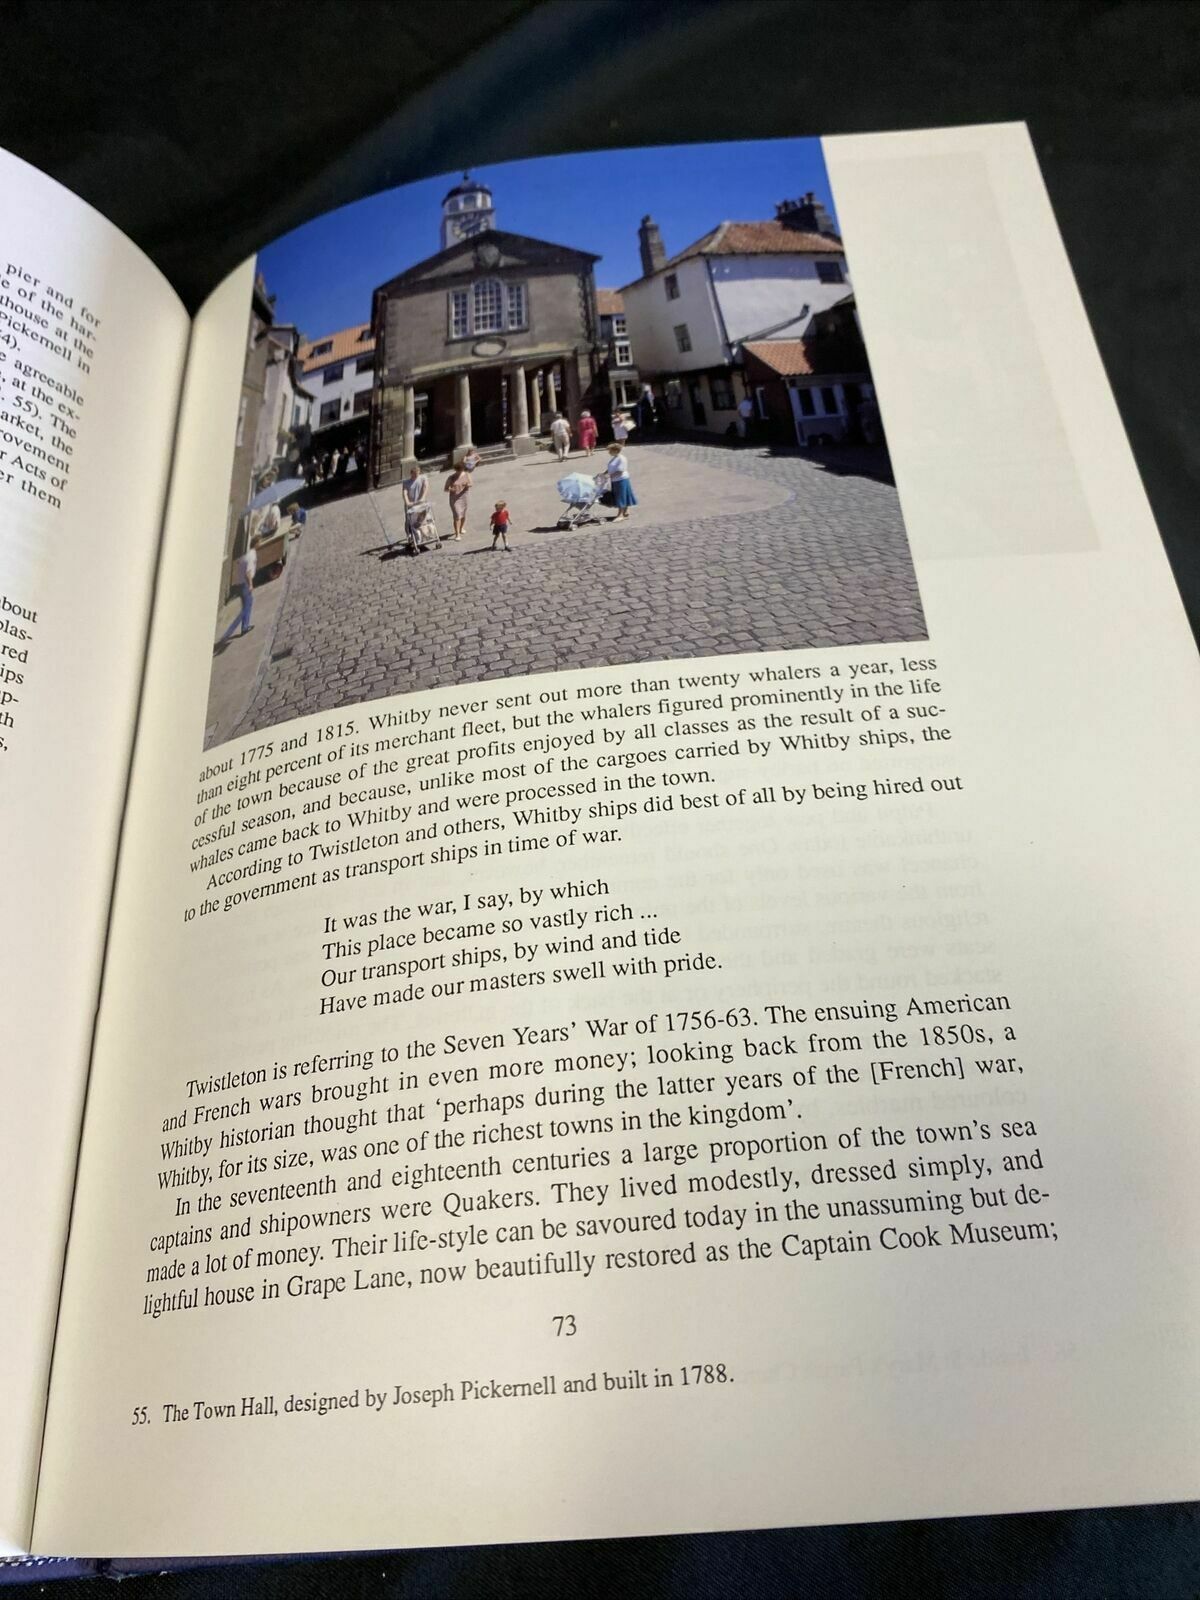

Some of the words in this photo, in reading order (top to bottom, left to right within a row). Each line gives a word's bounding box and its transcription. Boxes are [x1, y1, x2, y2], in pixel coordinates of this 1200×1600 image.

[0, 294, 48, 329] thouse
[55, 327, 68, 342] at
[74, 338, 94, 359] the
[6, 263, 41, 287] pier
[46, 286, 74, 309] and
[80, 306, 101, 328] for
[18, 288, 37, 302] of
[41, 300, 64, 320] the
[70, 316, 97, 342] har-
[14, 359, 84, 406] agreeable
[78, 356, 90, 375] in
[12, 377, 26, 392] at
[31, 386, 54, 406] the
[58, 402, 80, 421] ex-
[12, 395, 42, 420] 55).
[51, 414, 76, 439] The
[1, 410, 44, 441] arket,
[52, 434, 73, 456] the
[11, 456, 46, 481] Acts
[51, 476, 68, 491] of
[21, 480, 62, 510] them
[0, 596, 38, 624] bout
[198, 758, 234, 783] about
[240, 741, 274, 766] 1775
[280, 732, 308, 753] and
[316, 720, 360, 743] 1815.
[368, 708, 432, 730] Whitby
[438, 700, 489, 718] never
[495, 692, 533, 710] sent
[539, 688, 569, 704] out
[576, 684, 623, 700] more
[630, 678, 671, 694] than
[677, 672, 741, 690] twenty
[748, 665, 822, 682] whalers
[829, 665, 841, 677] a
[848, 662, 894, 680] year,
[900, 657, 938, 672] less
[191, 820, 236, 851] cessful
[240, 808, 296, 832] season,
[302, 794, 332, 816] and
[338, 783, 412, 807] because,
[418, 770, 475, 792] unlike
[481, 763, 527, 782] most
[533, 757, 555, 775] of
[560, 756, 590, 772] the
[596, 749, 668, 769] cargoes
[674, 739, 740, 760] carried
[746, 738, 772, 758] by
[778, 732, 851, 752] Whitby
[858, 728, 915, 748] ships,
[921, 726, 952, 742] the
[206, 856, 284, 891] According
[287, 852, 304, 867] to
[308, 832, 400, 861] Twistleton
[405, 822, 438, 843] and
[443, 817, 506, 837] others,
[511, 805, 583, 826] Whitby
[588, 800, 638, 820] ships
[643, 794, 675, 814] did
[679, 793, 721, 810] best
[725, 788, 747, 806] of
[752, 786, 777, 804] all
[781, 786, 807, 806] by
[811, 782, 869, 801] being
[872, 776, 925, 796] hired
[930, 776, 964, 792] out
[323, 916, 338, 934] It
[342, 912, 378, 930] was
[383, 905, 412, 924] the
[417, 900, 457, 917] war,
[463, 894, 471, 911] I
[477, 893, 514, 912] say,
[519, 886, 544, 908] by
[549, 878, 610, 900] which
[319, 995, 368, 1016] Have
[372, 983, 425, 1007] made
[431, 980, 466, 998] our
[469, 970, 546, 993] masters
[552, 960, 606, 984] swell
[611, 956, 658, 977] with
[663, 952, 723, 978] pride.
[321, 968, 358, 988] Our
[361, 953, 447, 981] transport
[451, 946, 508, 969] ships,
[513, 941, 539, 963] by
[544, 933, 595, 956] wind
[601, 929, 638, 950] and
[643, 926, 682, 947] tide
[185, 1068, 267, 1098] Twistleton
[272, 1062, 288, 1081] is
[292, 1050, 375, 1077] referring
[380, 1047, 399, 1064] to
[406, 1040, 437, 1060] the
[443, 1034, 505, 1055] Seven
[584, 1018, 629, 1038] War
[635, 1013, 659, 1035] of
[665, 1007, 759, 1032] 1756-63.
[763, 1004, 808, 1025] The
[814, 999, 899, 1023] ensuing
[905, 993, 1012, 1016] American
[160, 1135, 214, 1161] Whitby
[219, 1121, 296, 1150] historian
[303, 1108, 378, 1136] thought
[386, 1103, 426, 1124] that
[534, 1083, 606, 1107] during
[614, 1078, 649, 1100] the
[656, 1075, 716, 1096] latter
[724, 1072, 783, 1097] years
[792, 1064, 818, 1087] of
[825, 1064, 861, 1085] the
[870, 1056, 965, 1086] [French]
[974, 1058, 1024, 1074] war,
[149, 1224, 213, 1255] captains
[219, 1216, 252, 1241] and
[259, 1206, 371, 1238] shipowners
[380, 1200, 433, 1220] were
[442, 1188, 540, 1218] Quakers.
[550, 1181, 609, 1207] They
[619, 1173, 678, 1198] lived
[687, 1166, 800, 1194] modestly,
[810, 1158, 898, 1185] dressed
[907, 1153, 993, 1182] simply,
[1002, 1148, 1044, 1172] and
[142, 1287, 199, 1320] lightful
[203, 1285, 255, 1307] house
[261, 1278, 281, 1300] in
[286, 1274, 347, 1300] Grape
[353, 1269, 413, 1291] Lane,
[419, 1265, 467, 1285] now
[474, 1250, 596, 1280] beautifully
[604, 1241, 697, 1270] restored
[705, 1244, 730, 1262] as
[737, 1237, 773, 1260] the
[781, 1230, 872, 1262] Captain
[879, 1224, 943, 1250] Cook
[947, 1222, 1058, 1246] Museum;
[551, 1314, 577, 1337] 73
[131, 1406, 151, 1426] 55.
[162, 1404, 190, 1423] The
[192, 1401, 237, 1420] Town
[240, 1395, 279, 1417] Hall,
[283, 1389, 360, 1416] designed
[364, 1388, 388, 1412] by
[392, 1382, 455, 1408] Joseph
[460, 1375, 557, 1401] Pickernell
[563, 1372, 598, 1394] and
[602, 1369, 649, 1391] built
[653, 1368, 674, 1388] in
[680, 1362, 735, 1386] 1788.
